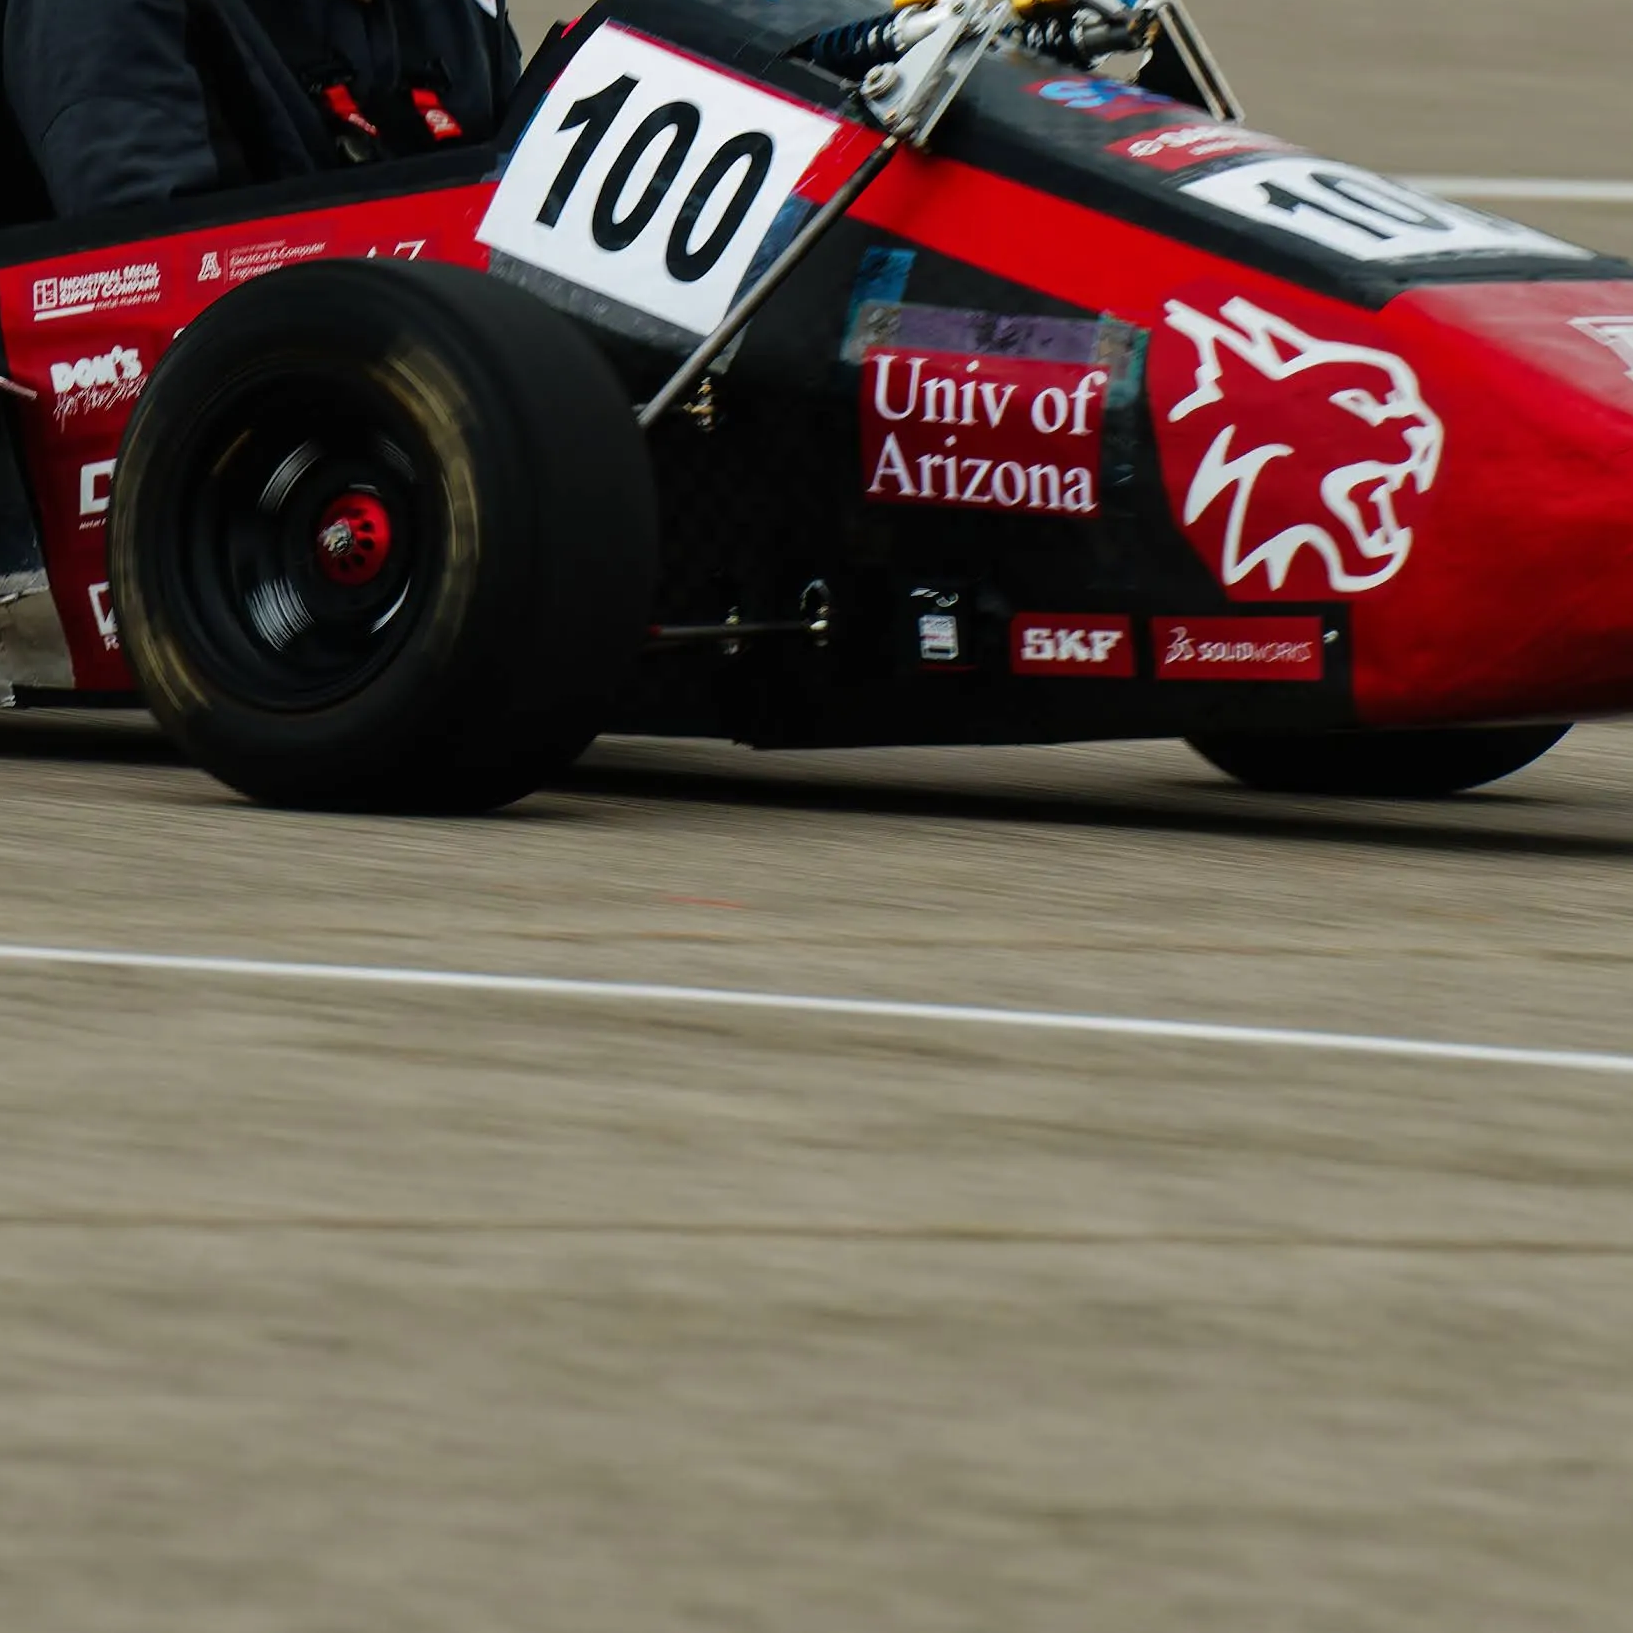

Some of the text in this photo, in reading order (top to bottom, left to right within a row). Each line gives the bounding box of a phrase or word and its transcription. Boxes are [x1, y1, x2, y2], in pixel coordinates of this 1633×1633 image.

[536, 73, 774, 282] 100
[874, 354, 1108, 436] Univ of
[866, 431, 1099, 513] Arizona
[1021, 627, 1124, 663] SKF
[1197, 639, 1313, 664] SOLIDWORKS
